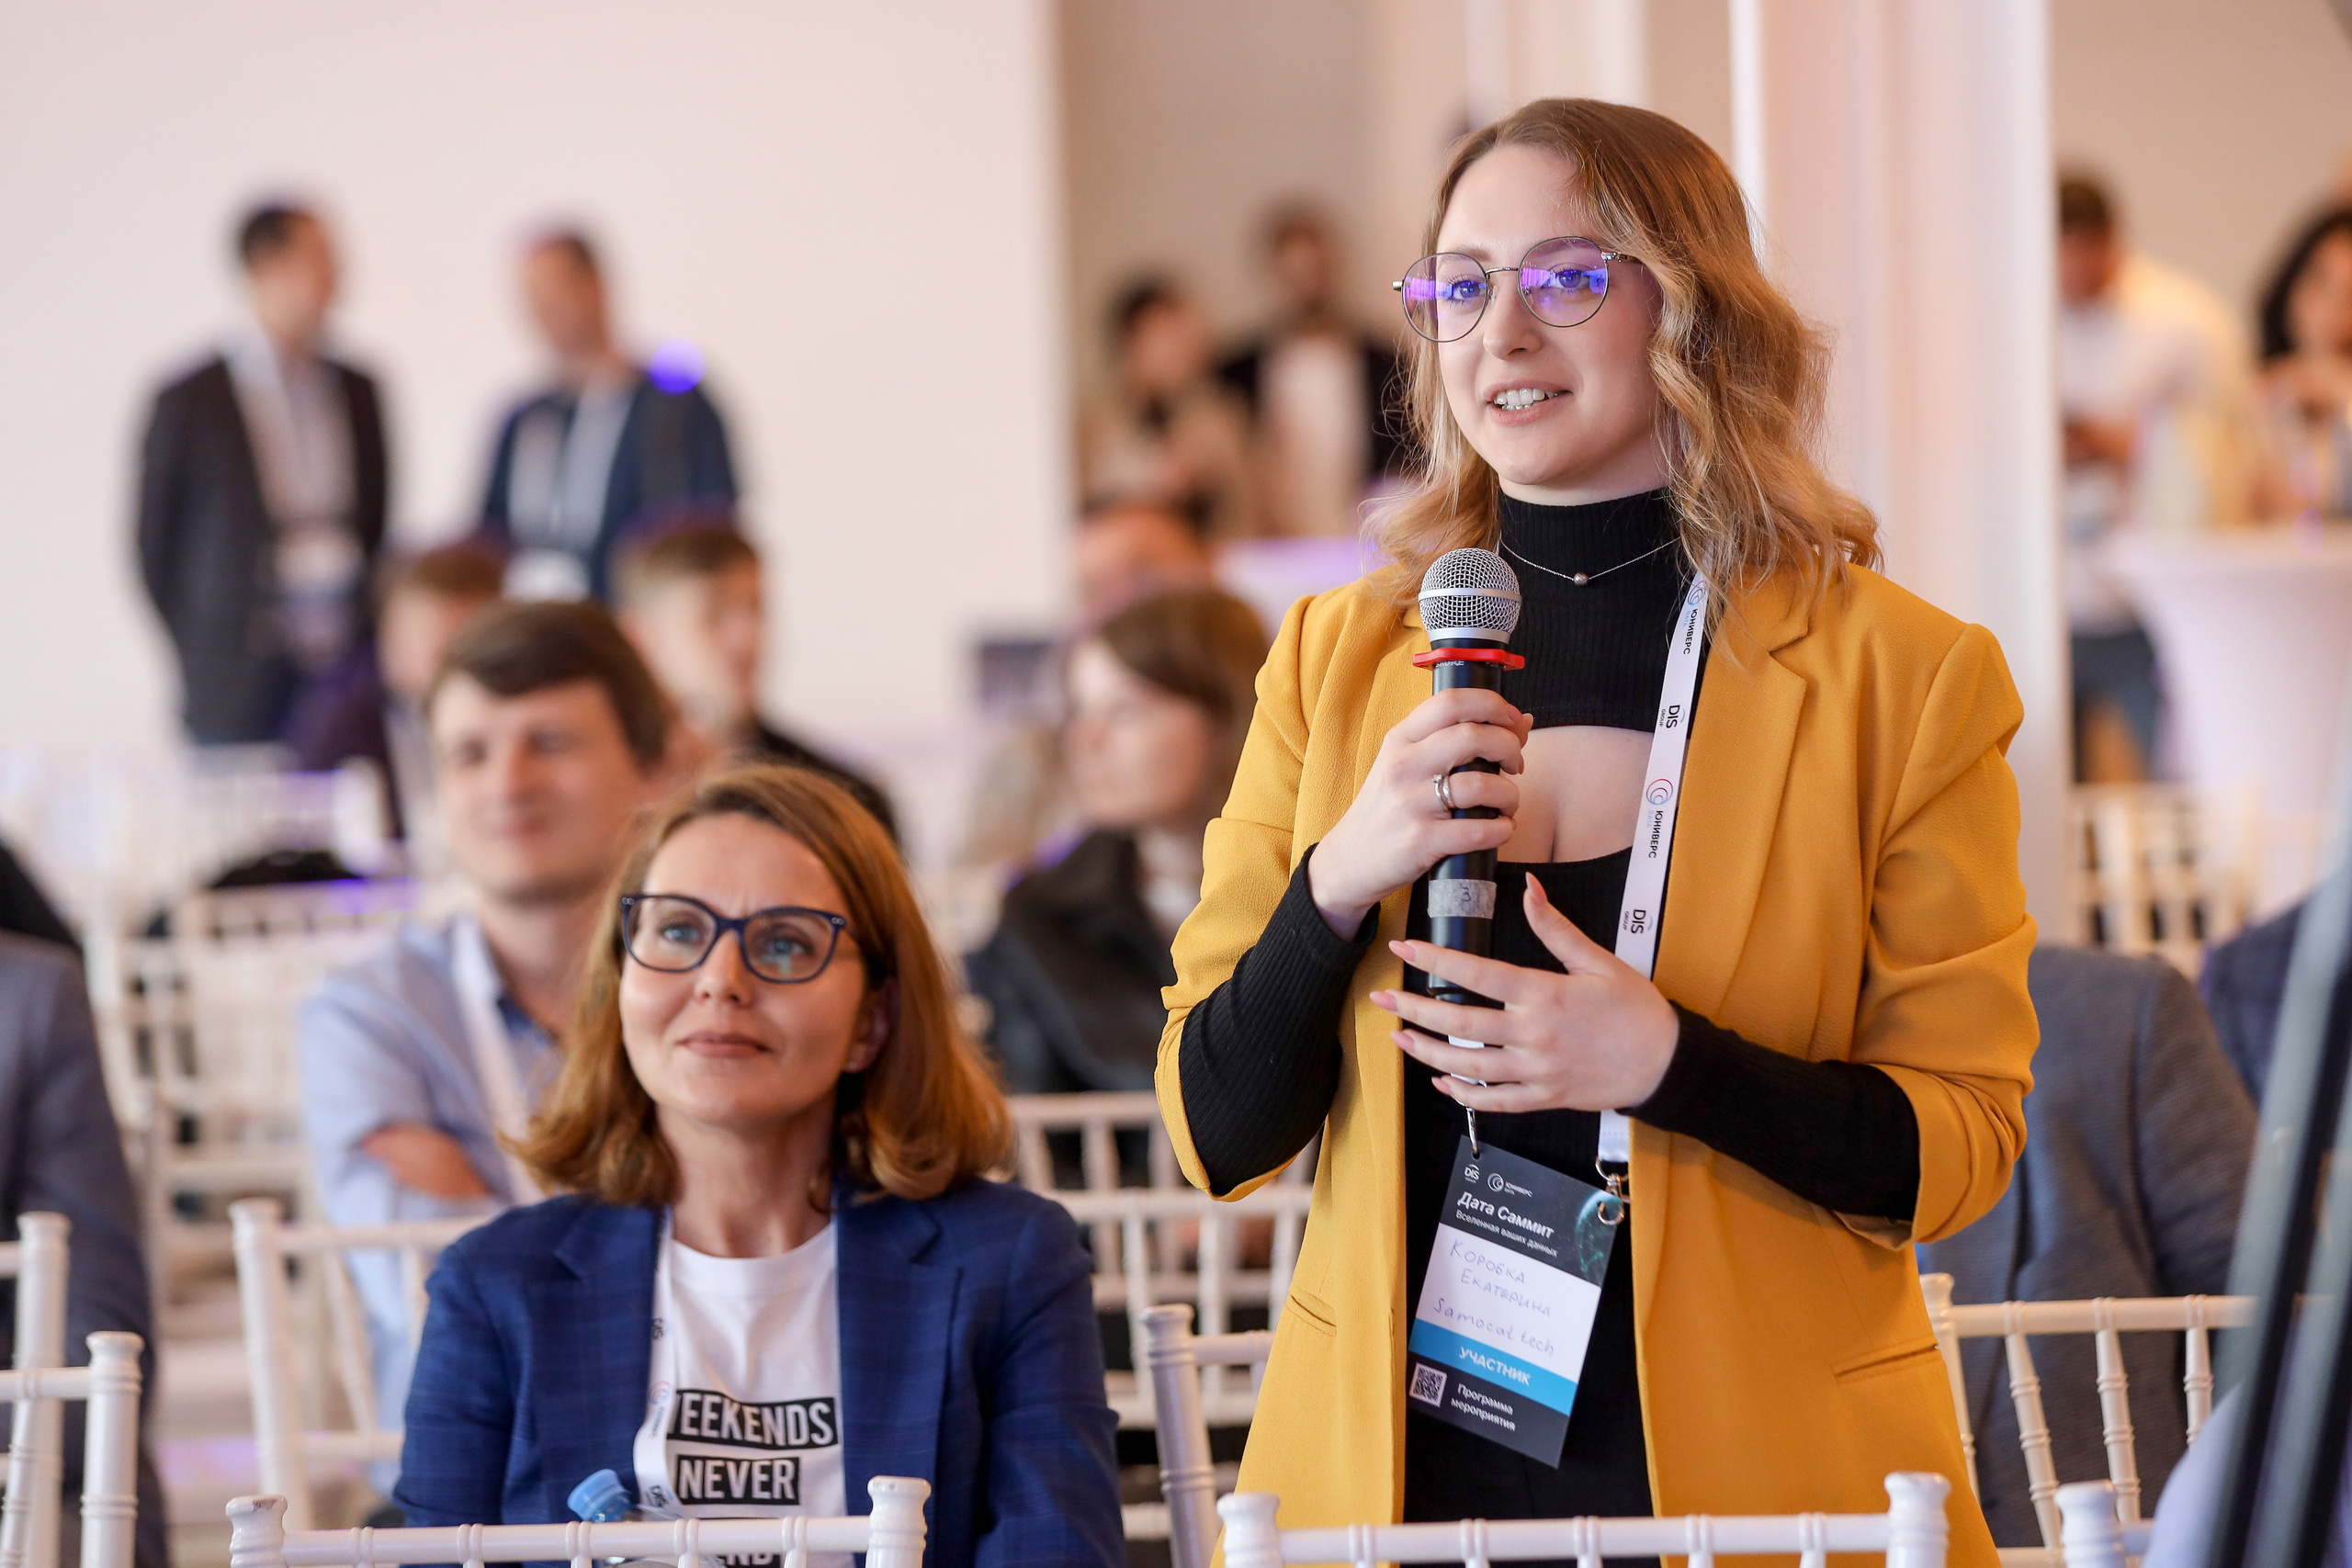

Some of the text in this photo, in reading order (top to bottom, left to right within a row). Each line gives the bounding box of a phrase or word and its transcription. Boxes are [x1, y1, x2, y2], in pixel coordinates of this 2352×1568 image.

[1683, 608, 1698, 655] ЮНИВЕРС
[1666, 705, 1680, 728] DIS
[1648, 810, 1664, 859] ЮНИВЕРС
[1631, 908, 1646, 934] DIS
[1464, 1166, 1480, 1181] DIS
[1455, 1209, 1558, 1258] Вселенная ваших данных
[1456, 1190, 1555, 1239] Дата Саммит
[1459, 1346, 1532, 1386] УЧАСТНИК
[1451, 1397, 1516, 1432] мероприятия
[1457, 1382, 1514, 1416] Программа
[678, 1459, 797, 1500] NEVER
